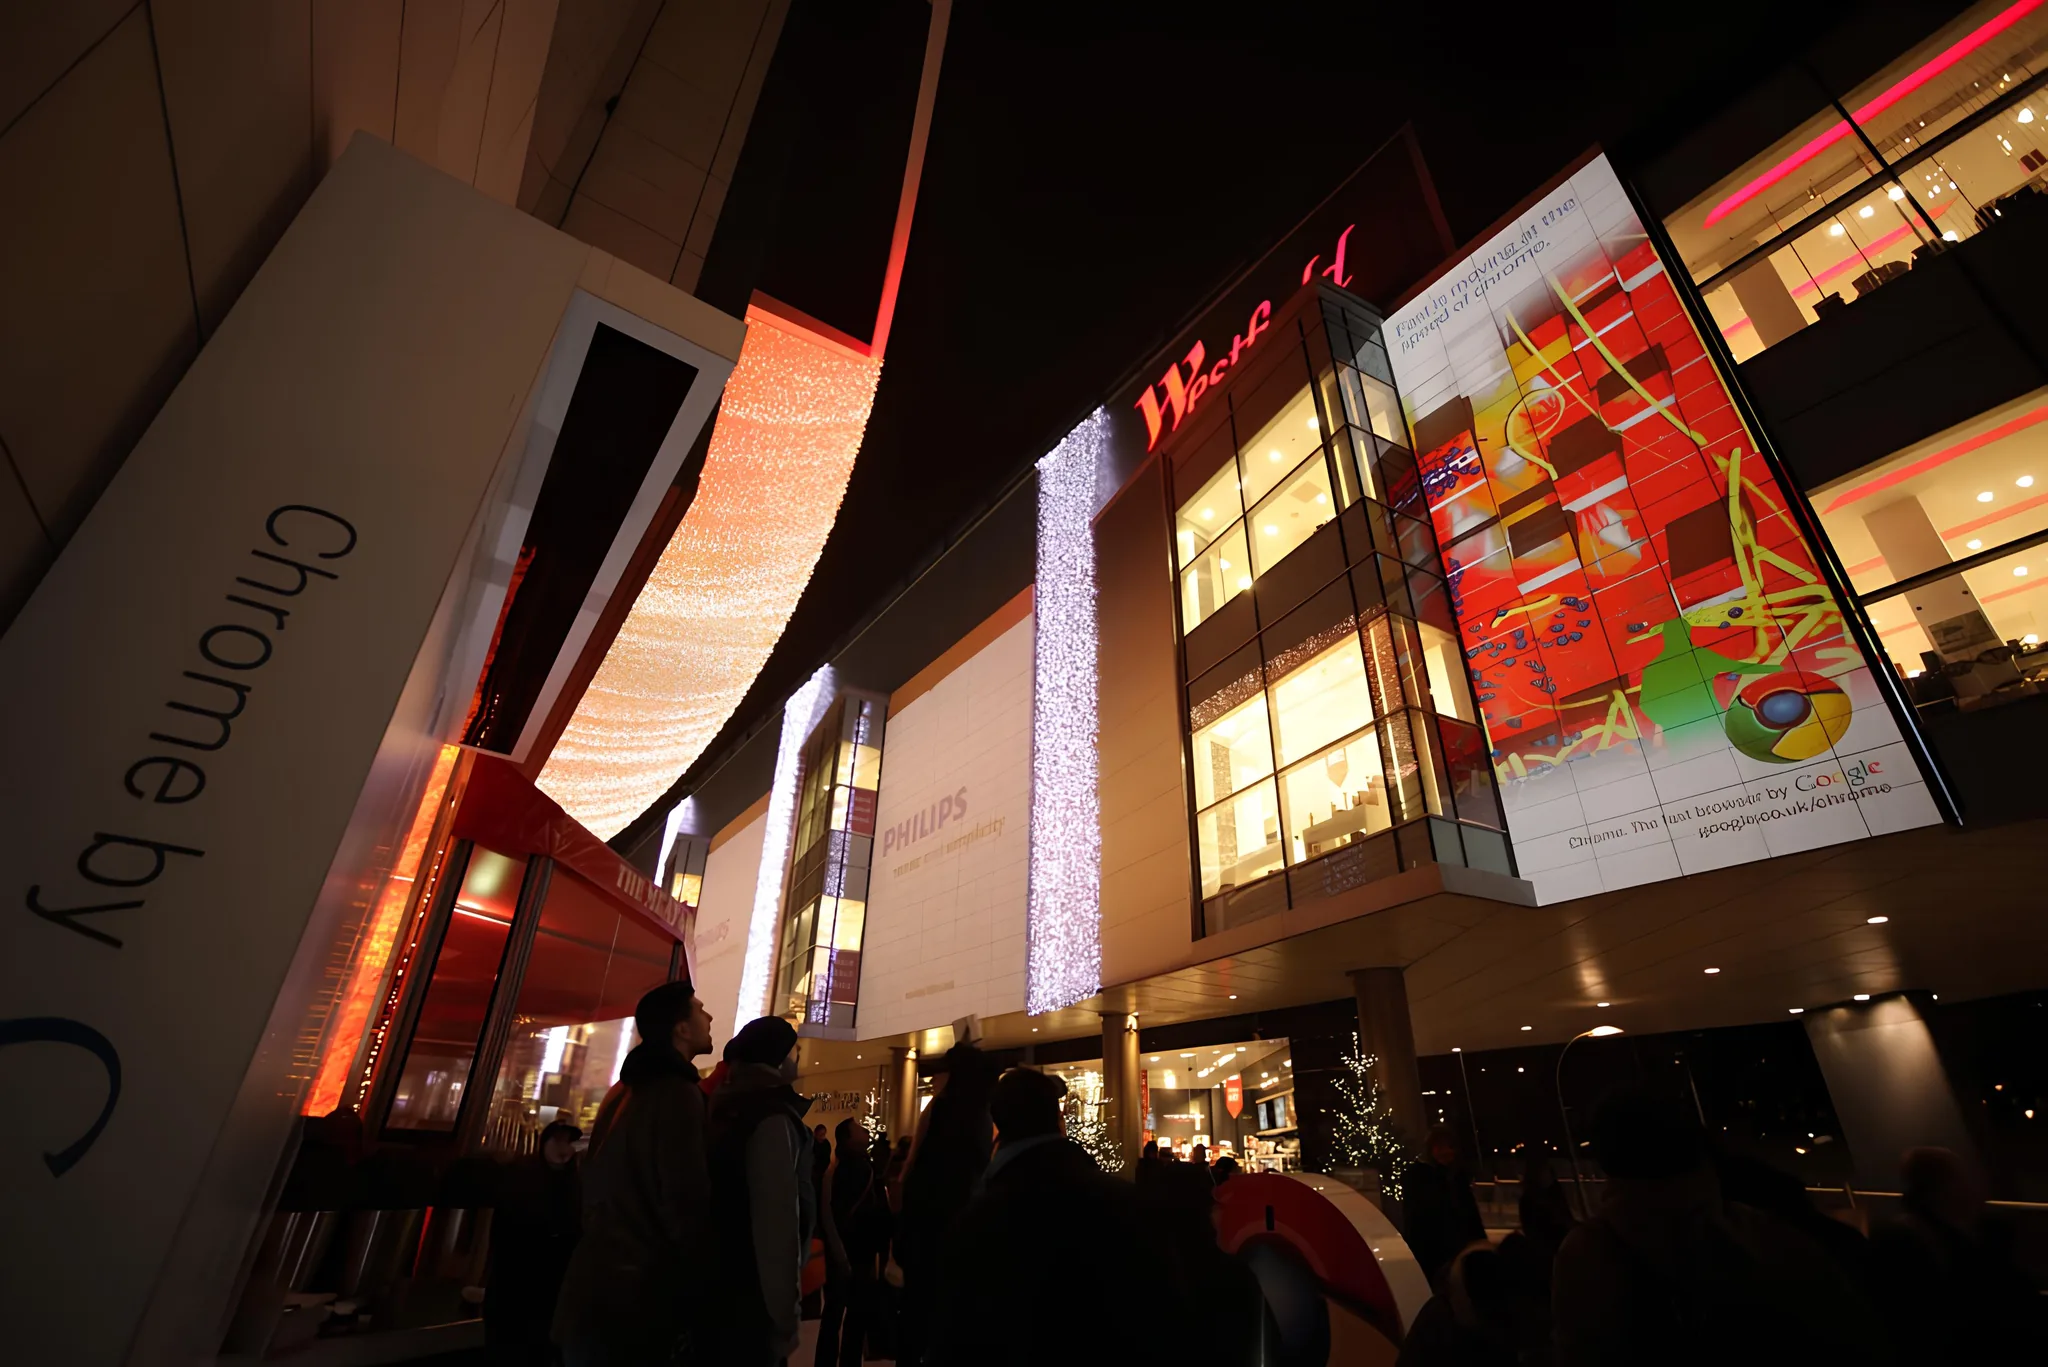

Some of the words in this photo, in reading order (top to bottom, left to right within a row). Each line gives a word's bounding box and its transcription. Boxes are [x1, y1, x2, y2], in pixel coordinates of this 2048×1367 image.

[124, 504, 357, 805] Chrome
[882, 786, 967, 857] PHILIPS
[1765, 786, 1789, 806] by
[26, 832, 205, 949] by
